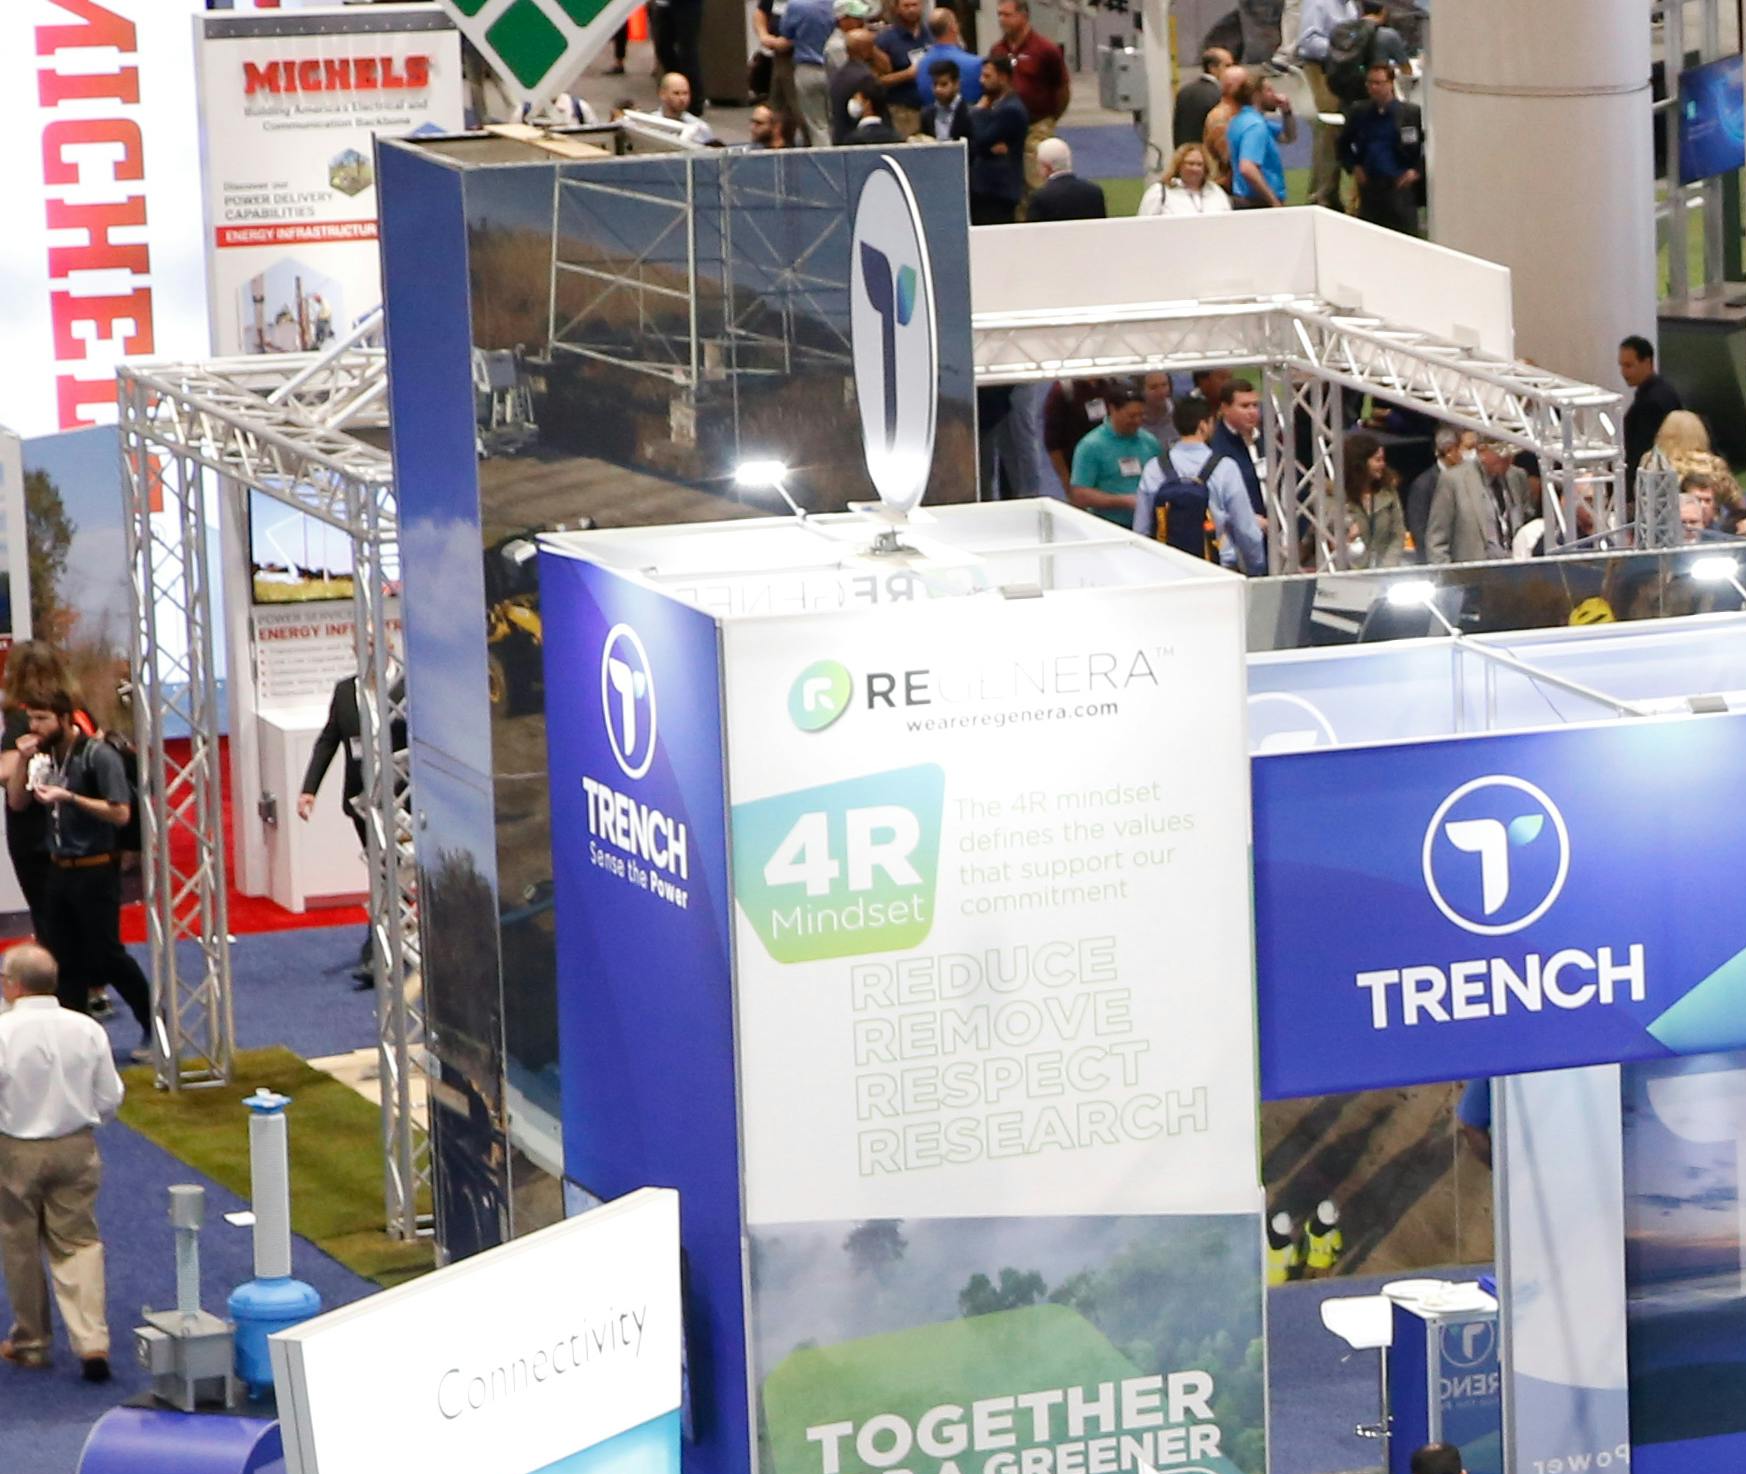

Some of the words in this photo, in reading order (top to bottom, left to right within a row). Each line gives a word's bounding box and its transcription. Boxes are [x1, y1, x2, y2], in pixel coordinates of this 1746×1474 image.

[243, 55, 430, 95] MICHELS
[225, 205, 315, 220] CAPABILITIES
[274, 192, 333, 204] DELIVERY
[225, 229, 275, 243] ENERGY
[276, 223, 378, 240] INFRASTRUCTUR
[258, 624, 321, 640] ENERGY
[906, 700, 1119, 734] weareregenera.com
[1008, 790, 1047, 815] 4R
[1055, 780, 1161, 810] mindset
[582, 776, 689, 880] TRENCH
[958, 827, 1056, 854] defines
[1064, 820, 1109, 844] the
[1114, 813, 1195, 838] values
[764, 804, 922, 898] 4R
[958, 860, 1012, 886] that
[1019, 851, 1125, 885] support
[1133, 846, 1177, 866] our
[588, 841, 626, 880] Sense
[628, 856, 648, 890] the
[649, 869, 690, 910] Power
[771, 894, 926, 938] Mindset
[959, 879, 1128, 917] commitment
[850, 936, 1118, 1012] REDUCE
[1356, 943, 1645, 1031] TRENCH
[853, 988, 1133, 1067] REMOVE
[855, 1040, 1149, 1122] RESPECT
[857, 1087, 1208, 1178] RESEARCH
[437, 1304, 648, 1420] Connectivity
[807, 1369, 1215, 1474] TOGETHER
